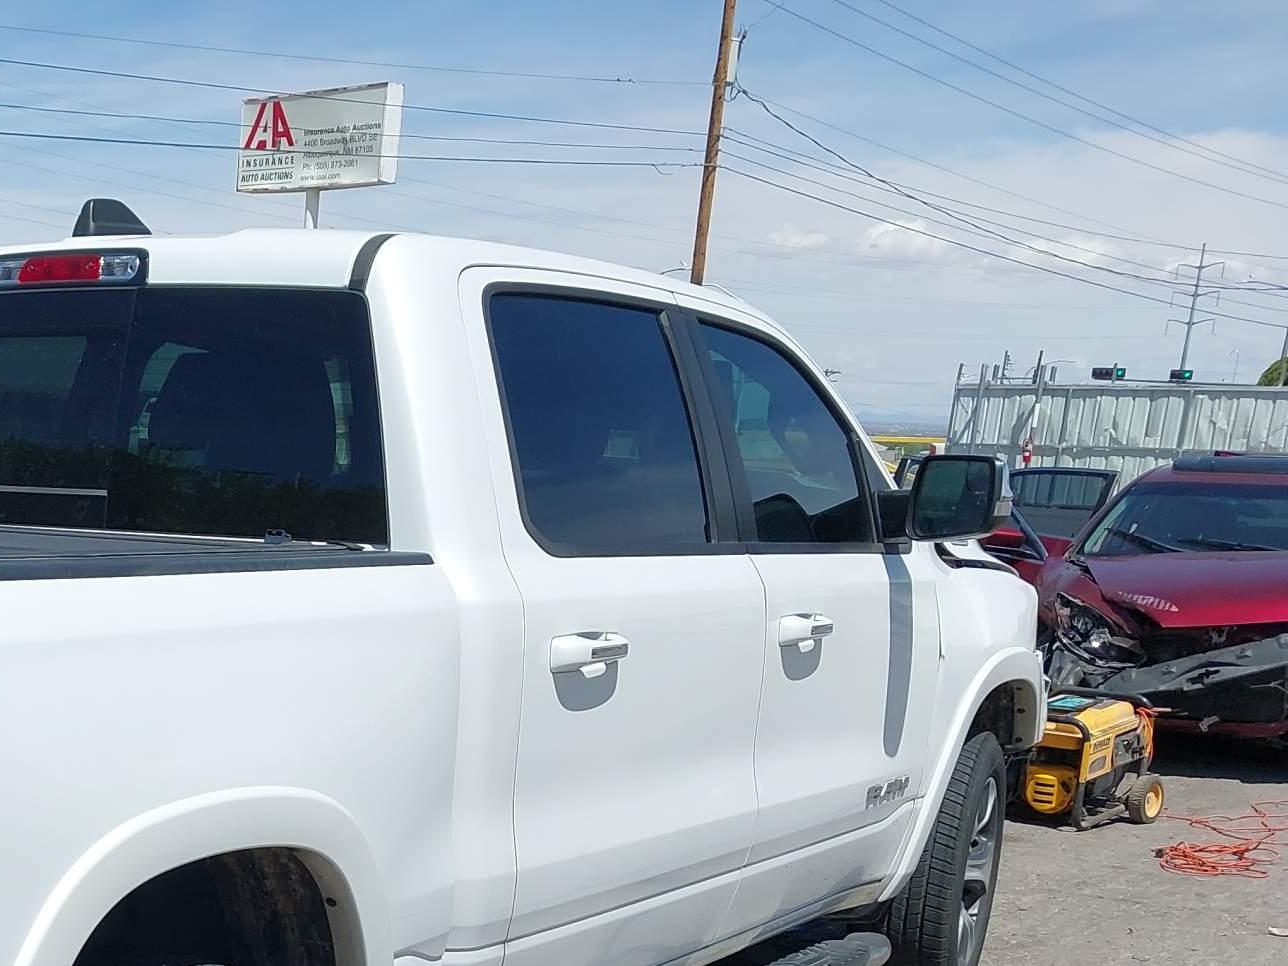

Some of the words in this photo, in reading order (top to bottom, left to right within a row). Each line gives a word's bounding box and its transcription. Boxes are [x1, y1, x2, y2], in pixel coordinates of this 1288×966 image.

[352, 122, 382, 131] Auctions
[241, 155, 296, 169] INSURANCE
[240, 173, 259, 183] AUTO
[260, 170, 294, 181] AUCTIONS
